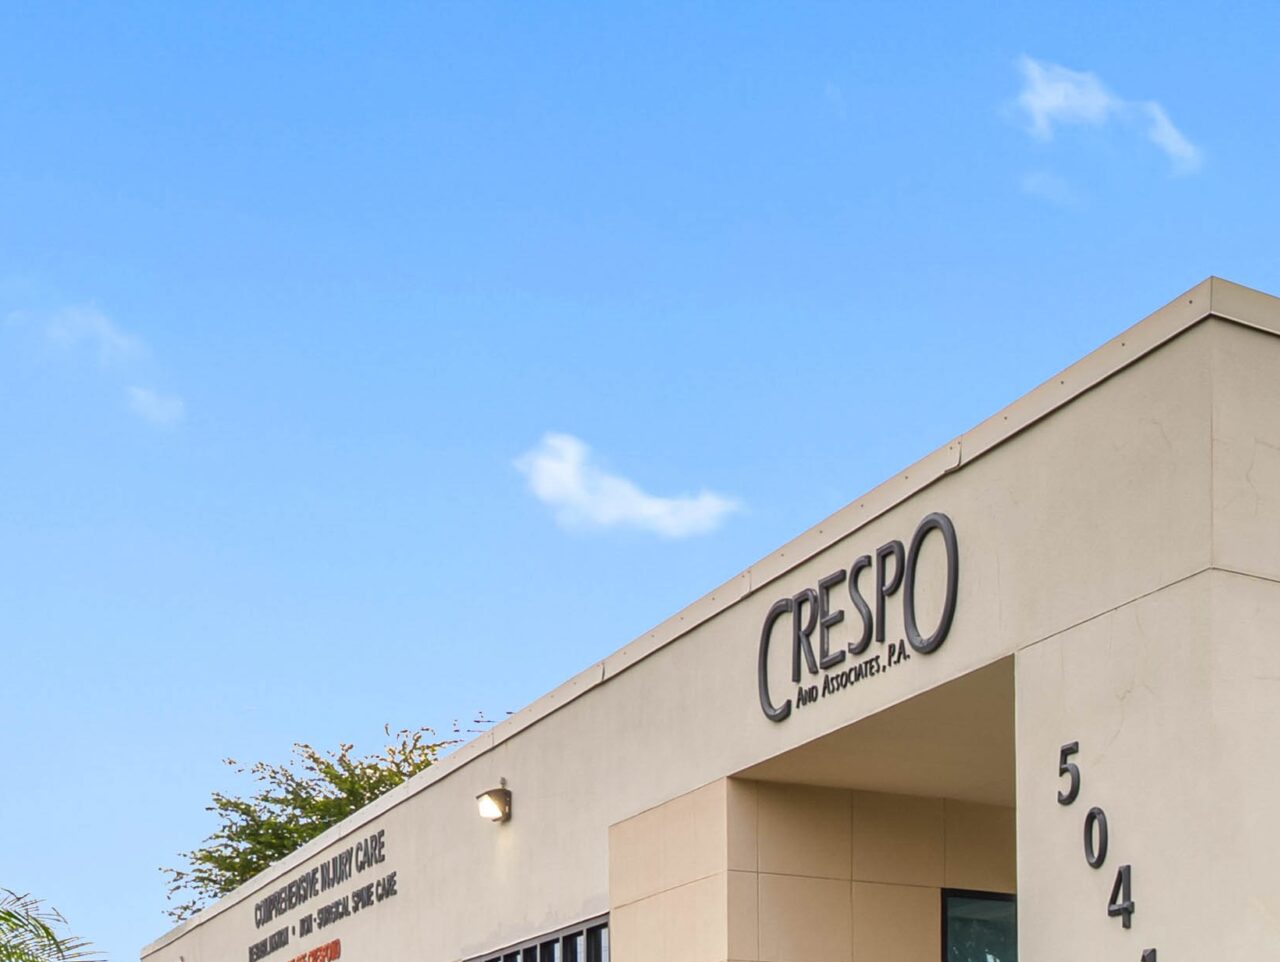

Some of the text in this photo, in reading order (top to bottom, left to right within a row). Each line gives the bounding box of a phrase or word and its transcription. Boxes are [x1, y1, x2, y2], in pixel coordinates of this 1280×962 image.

[758, 512, 959, 723] CRESPO
[796, 639, 911, 709] AND ASSOCIATES, P.A.
[254, 829, 386, 929] COMPREHENSIVE INJURY CARE
[351, 882, 375, 914] SPINE
[375, 871, 398, 903] CARE
